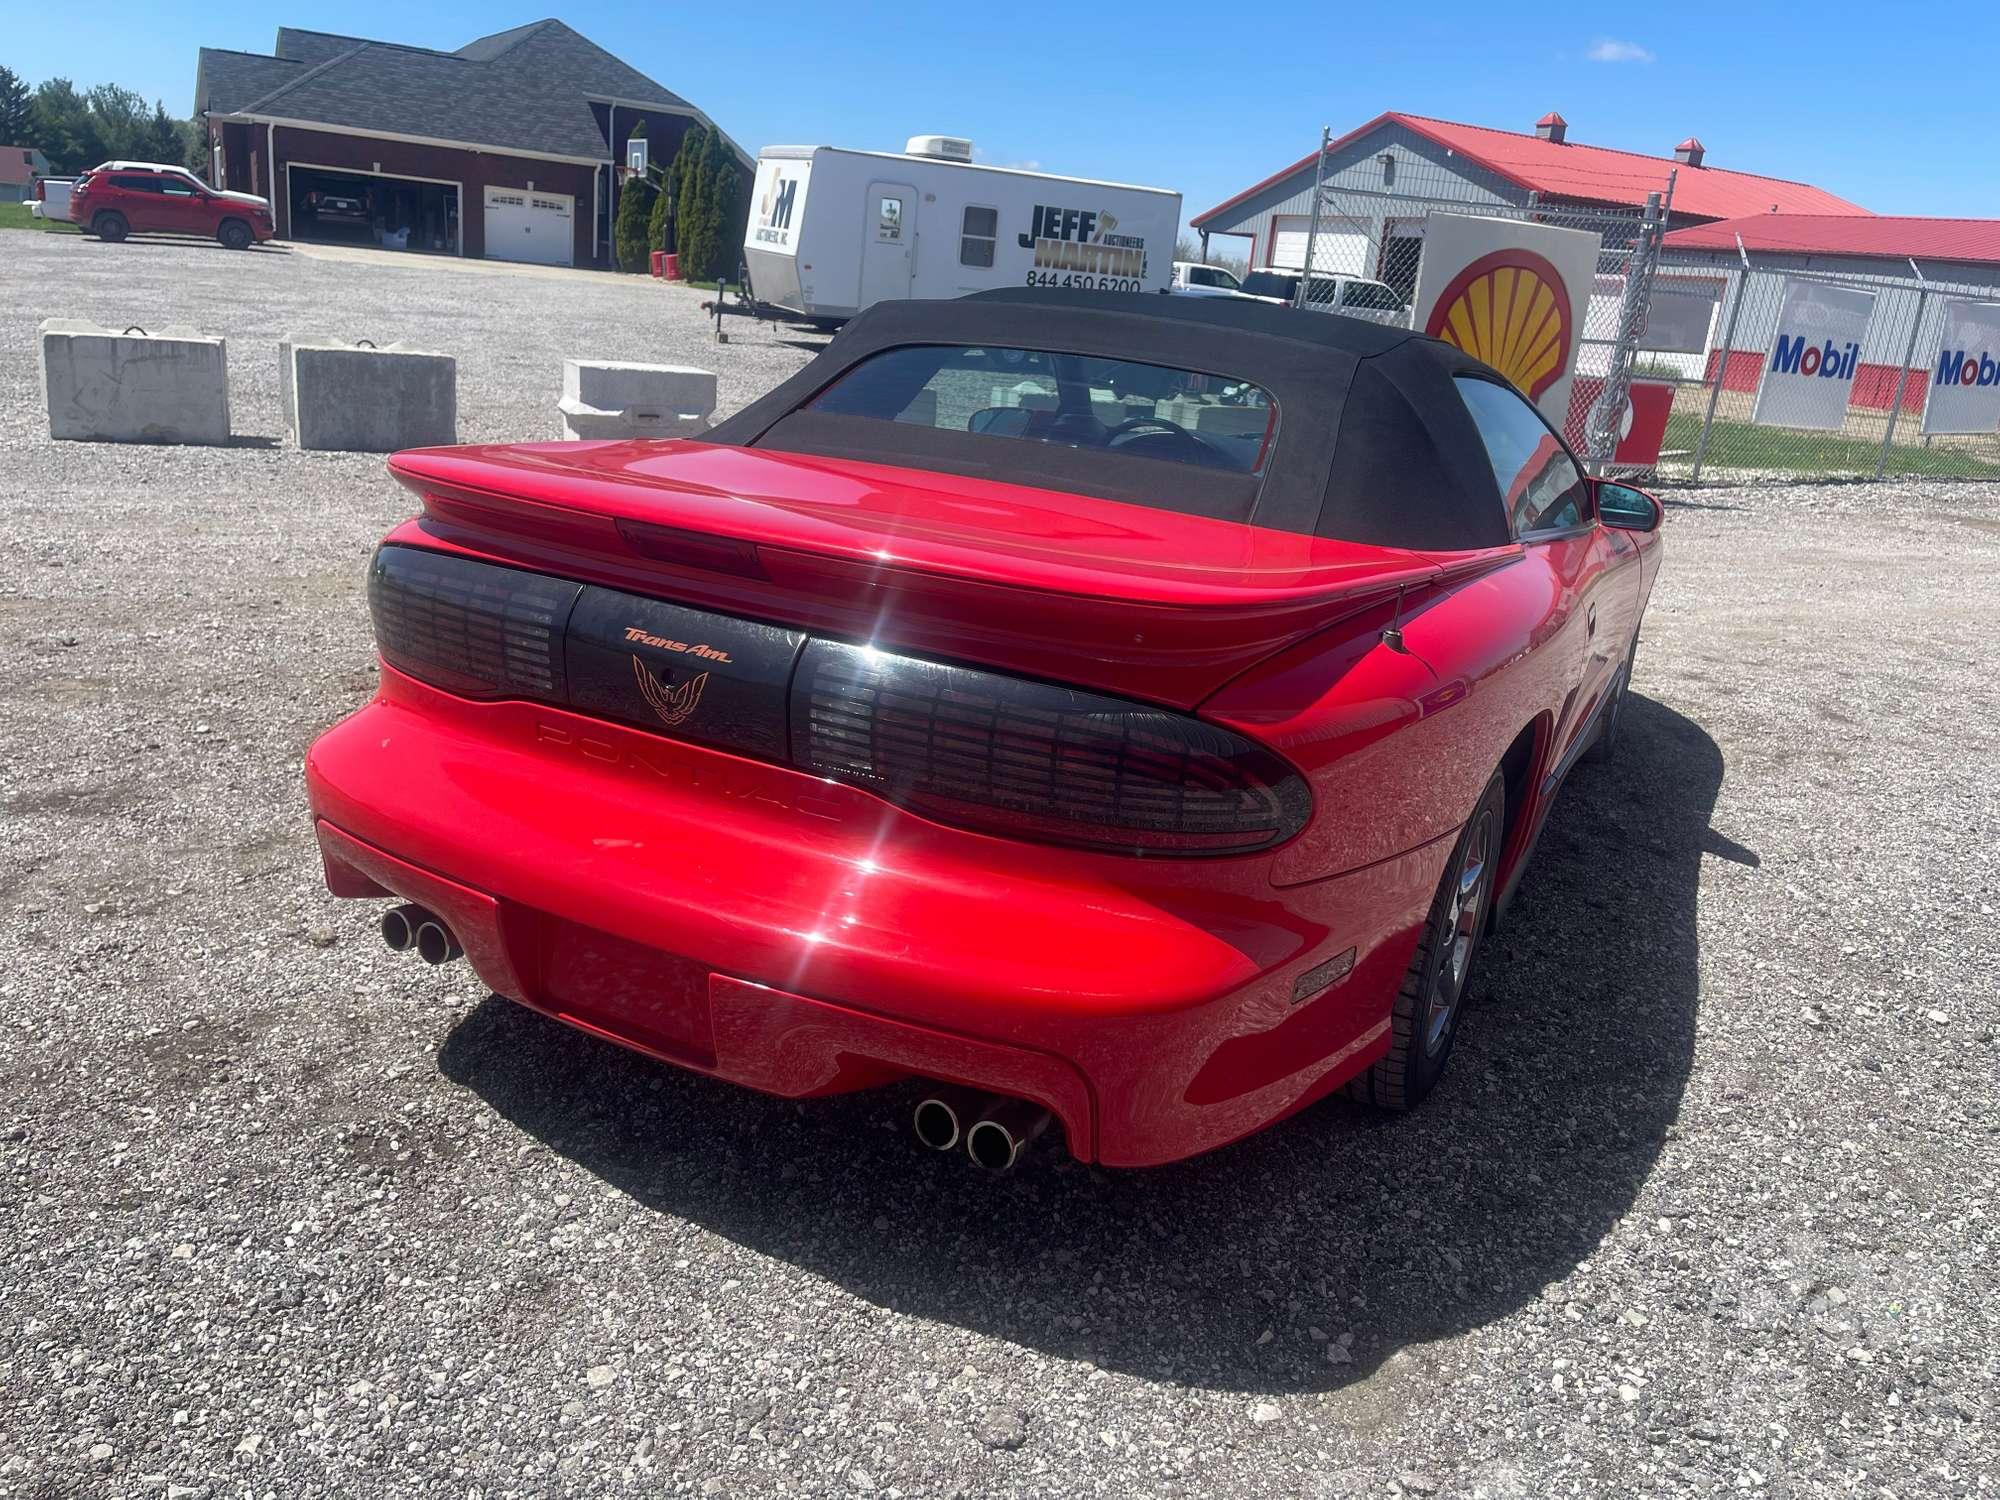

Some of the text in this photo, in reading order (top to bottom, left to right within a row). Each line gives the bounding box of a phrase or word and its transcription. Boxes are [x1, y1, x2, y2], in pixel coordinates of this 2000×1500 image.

[1018, 204, 1097, 249] JEFF
[1034, 238, 1143, 278] MARTIN
[1772, 334, 1860, 380] Mobil
[624, 627, 734, 663] Trans Am
[536, 724, 842, 823] PONTIAC
